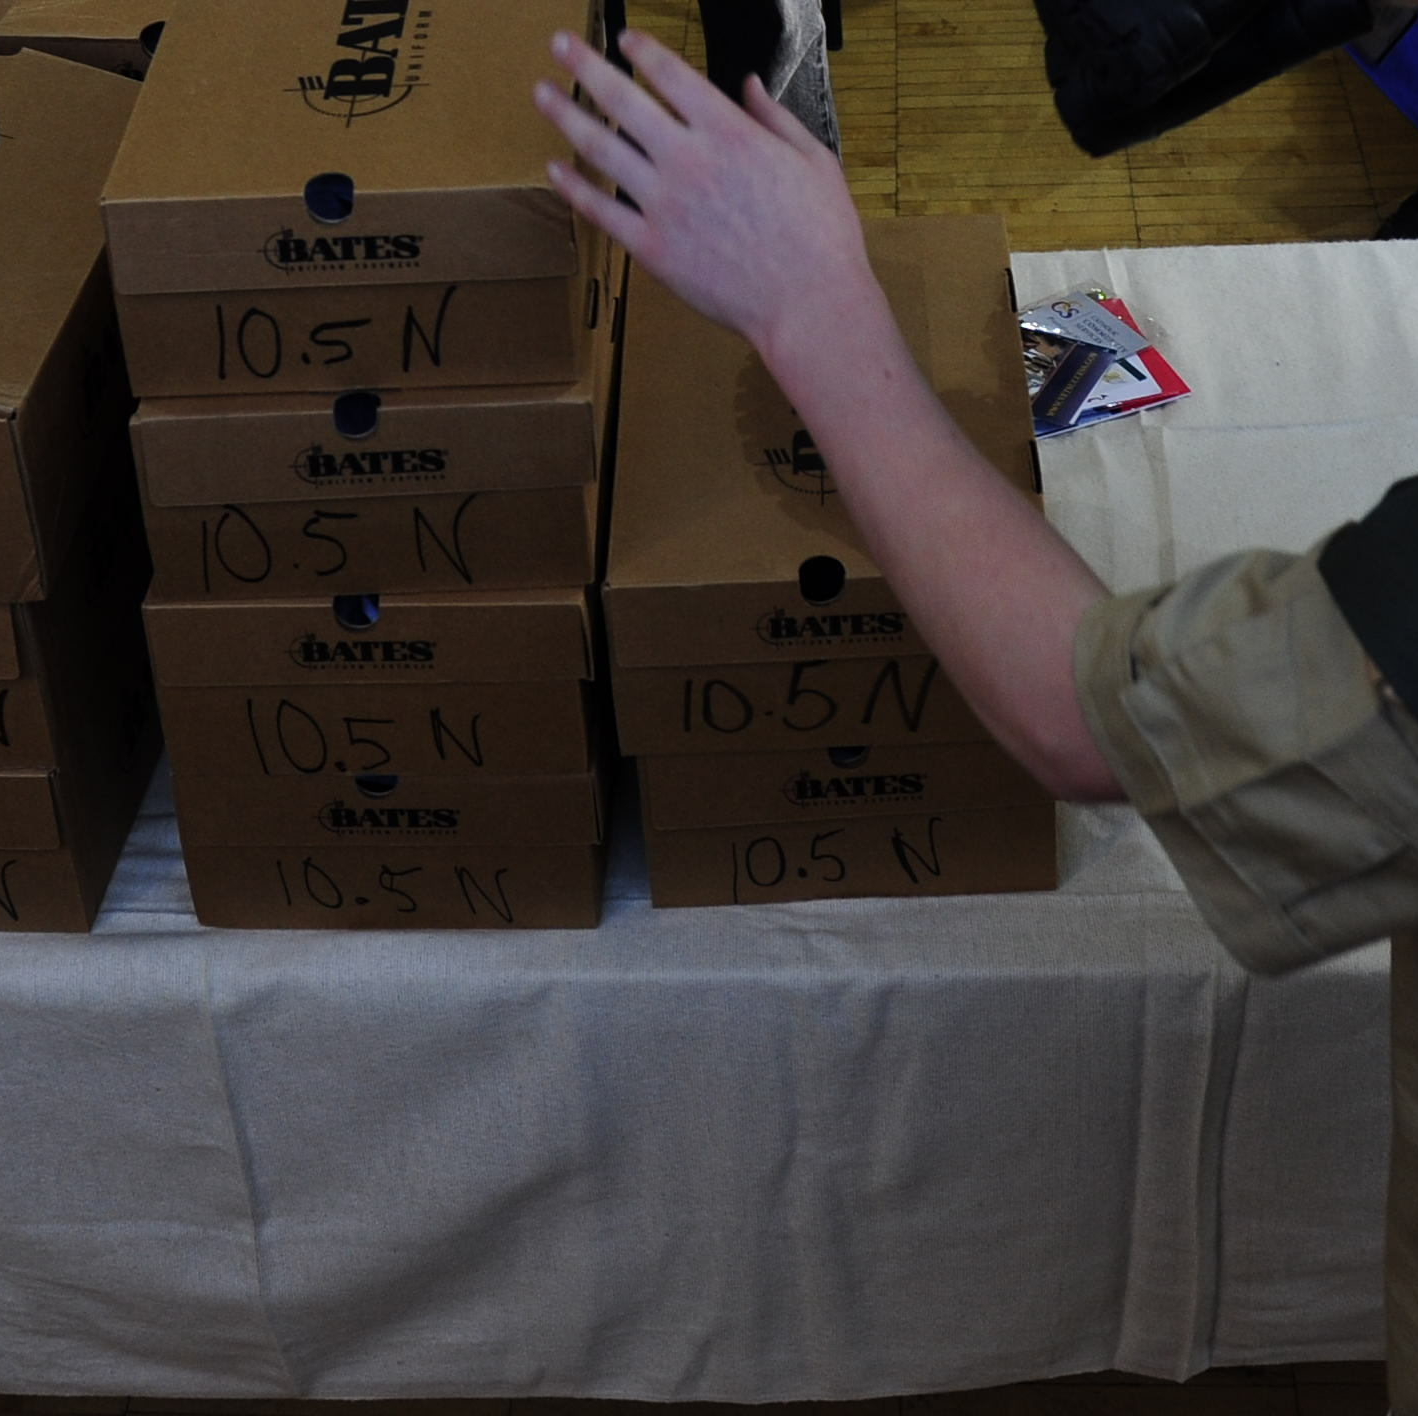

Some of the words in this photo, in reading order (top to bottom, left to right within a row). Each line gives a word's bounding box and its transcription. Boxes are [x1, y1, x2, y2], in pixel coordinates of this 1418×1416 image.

[277, 235, 422, 262] BATES
[216, 304, 372, 380] 10.5
[403, 285, 457, 372] N
[306, 449, 446, 478] BATES
[202, 503, 358, 594] 10.5
[414, 492, 478, 584] N
[770, 612, 905, 639] BATES
[302, 641, 434, 663] BATES
[683, 659, 838, 733] 10.5
[862, 657, 940, 732] N
[247, 699, 395, 775] 10.5
[431, 707, 483, 767] N
[796, 775, 926, 800] BATES
[330, 808, 459, 829] BATES
[732, 829, 846, 904] 10.5
[891, 816, 942, 884] N
[277, 857, 422, 912] 10.5
[454, 866, 513, 922] N
